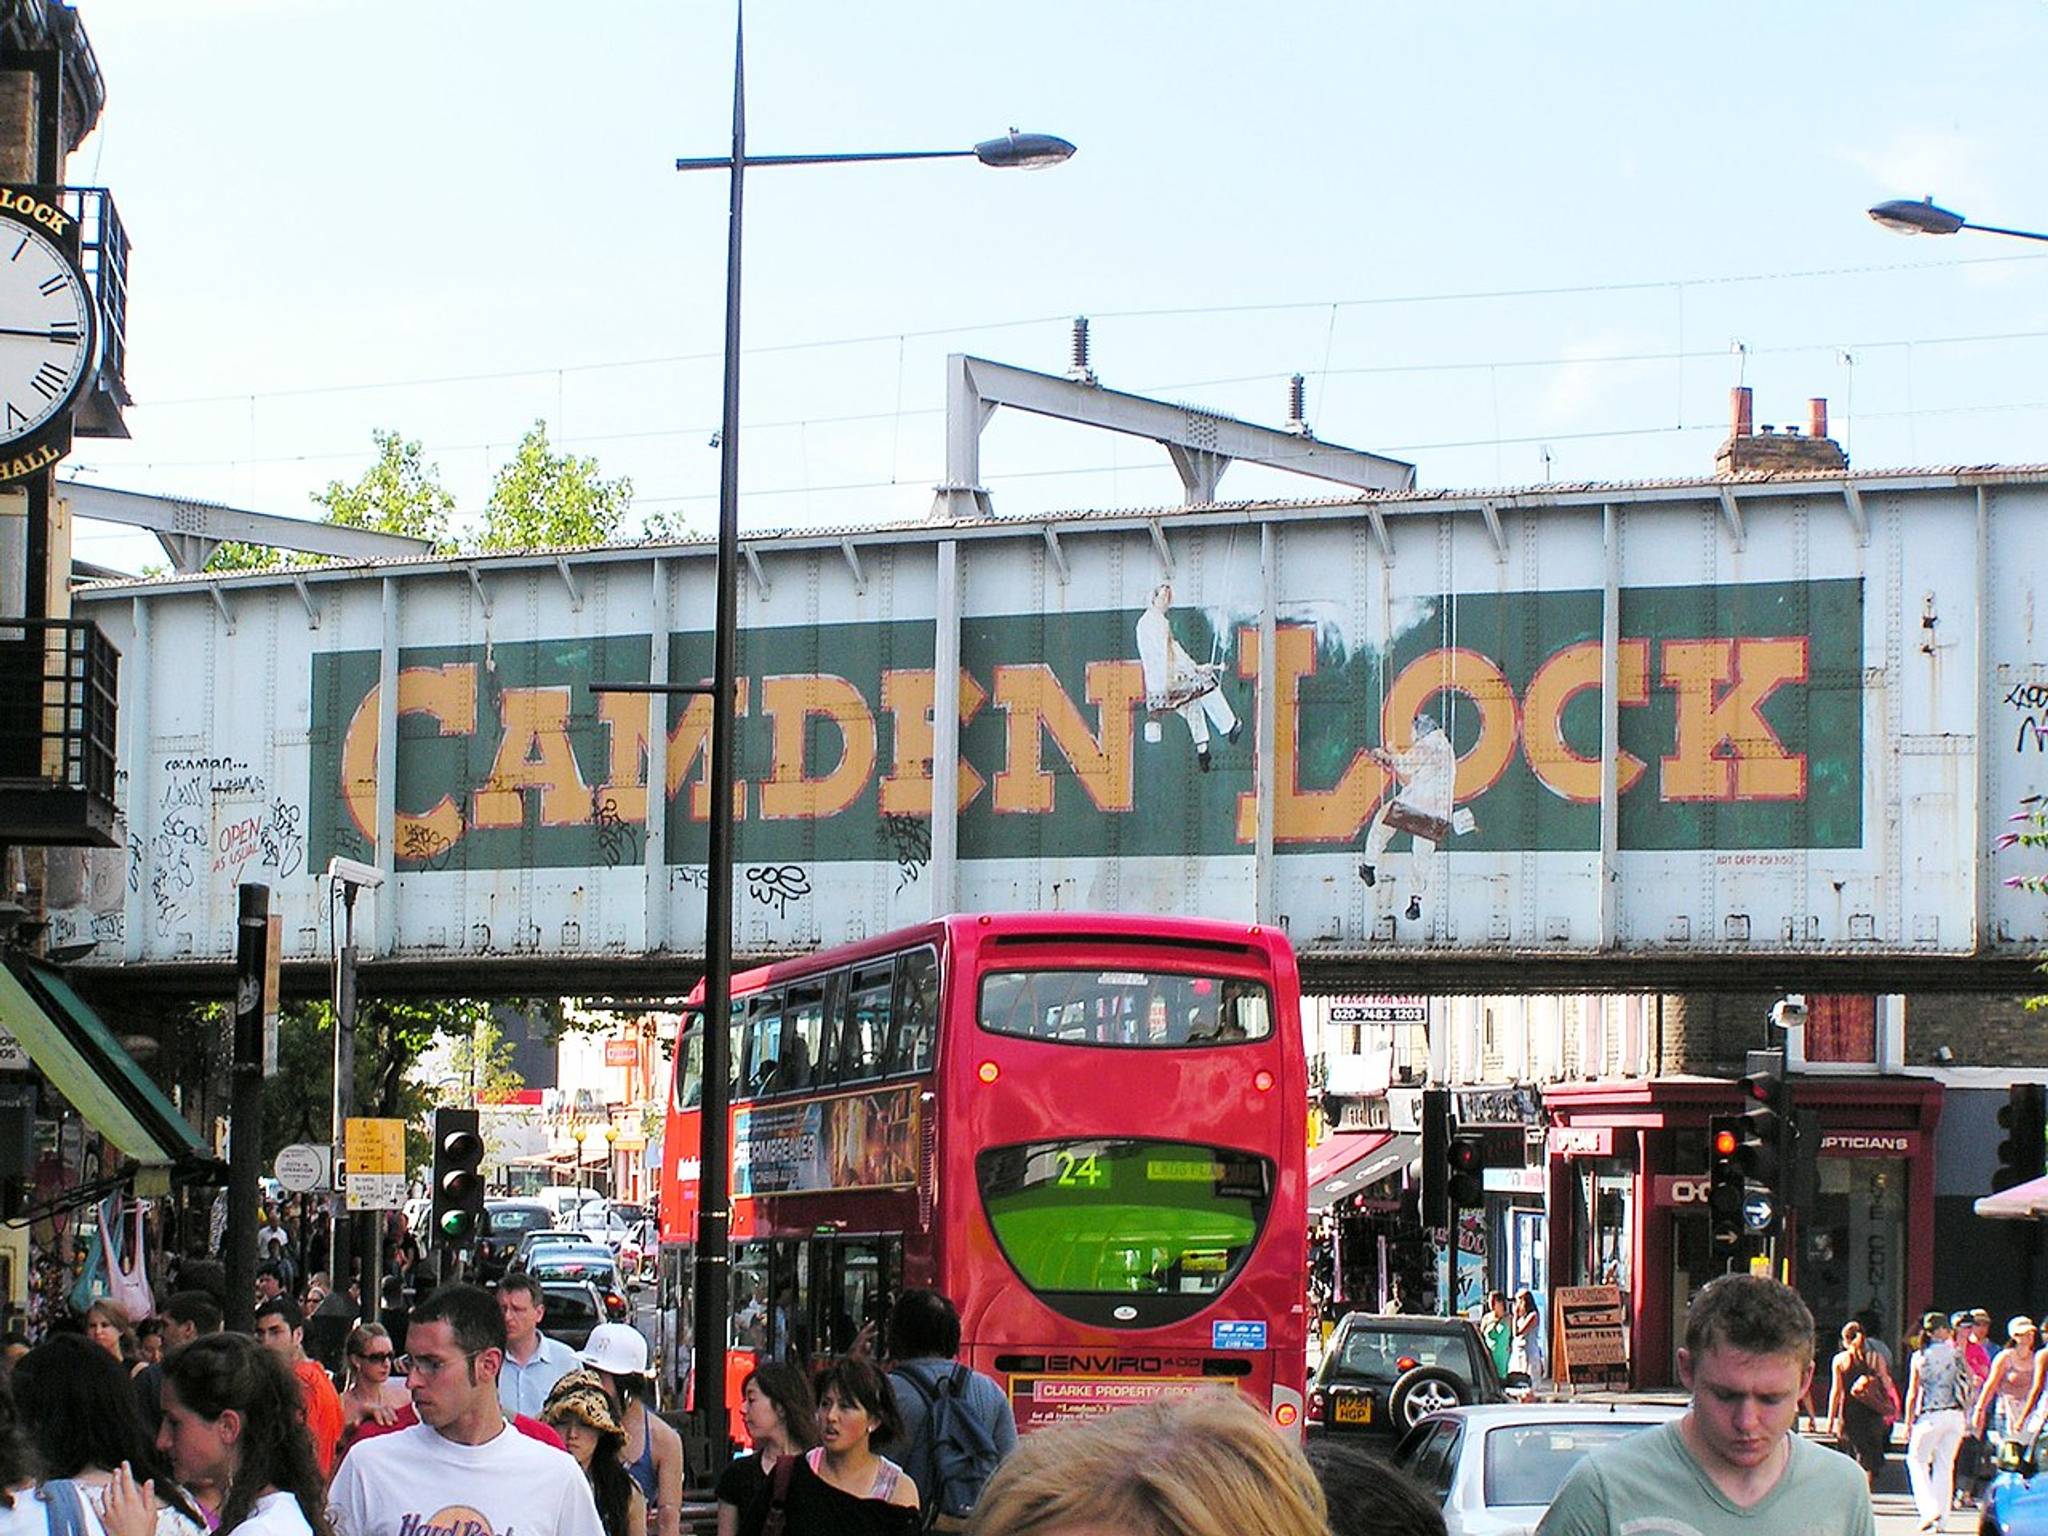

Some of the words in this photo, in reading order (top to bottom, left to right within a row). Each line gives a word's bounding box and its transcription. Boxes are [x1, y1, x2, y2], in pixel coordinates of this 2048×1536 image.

[0, 188, 70, 236] LOCK
[342, 659, 1147, 862] CAMDEN
[1236, 620, 1809, 844] LOCK
[219, 815, 262, 853] OPEN
[213, 856, 226, 873] AS
[1394, 1009, 1423, 1020] 1203
[1821, 1136, 1909, 1150] PTICIANS
[1055, 1150, 1102, 1186] 24
[1048, 1355, 1162, 1373] ENVIRO
[1044, 1385, 1092, 1397] CLARKE
[1095, 1386, 1160, 1398] PROPERTY
